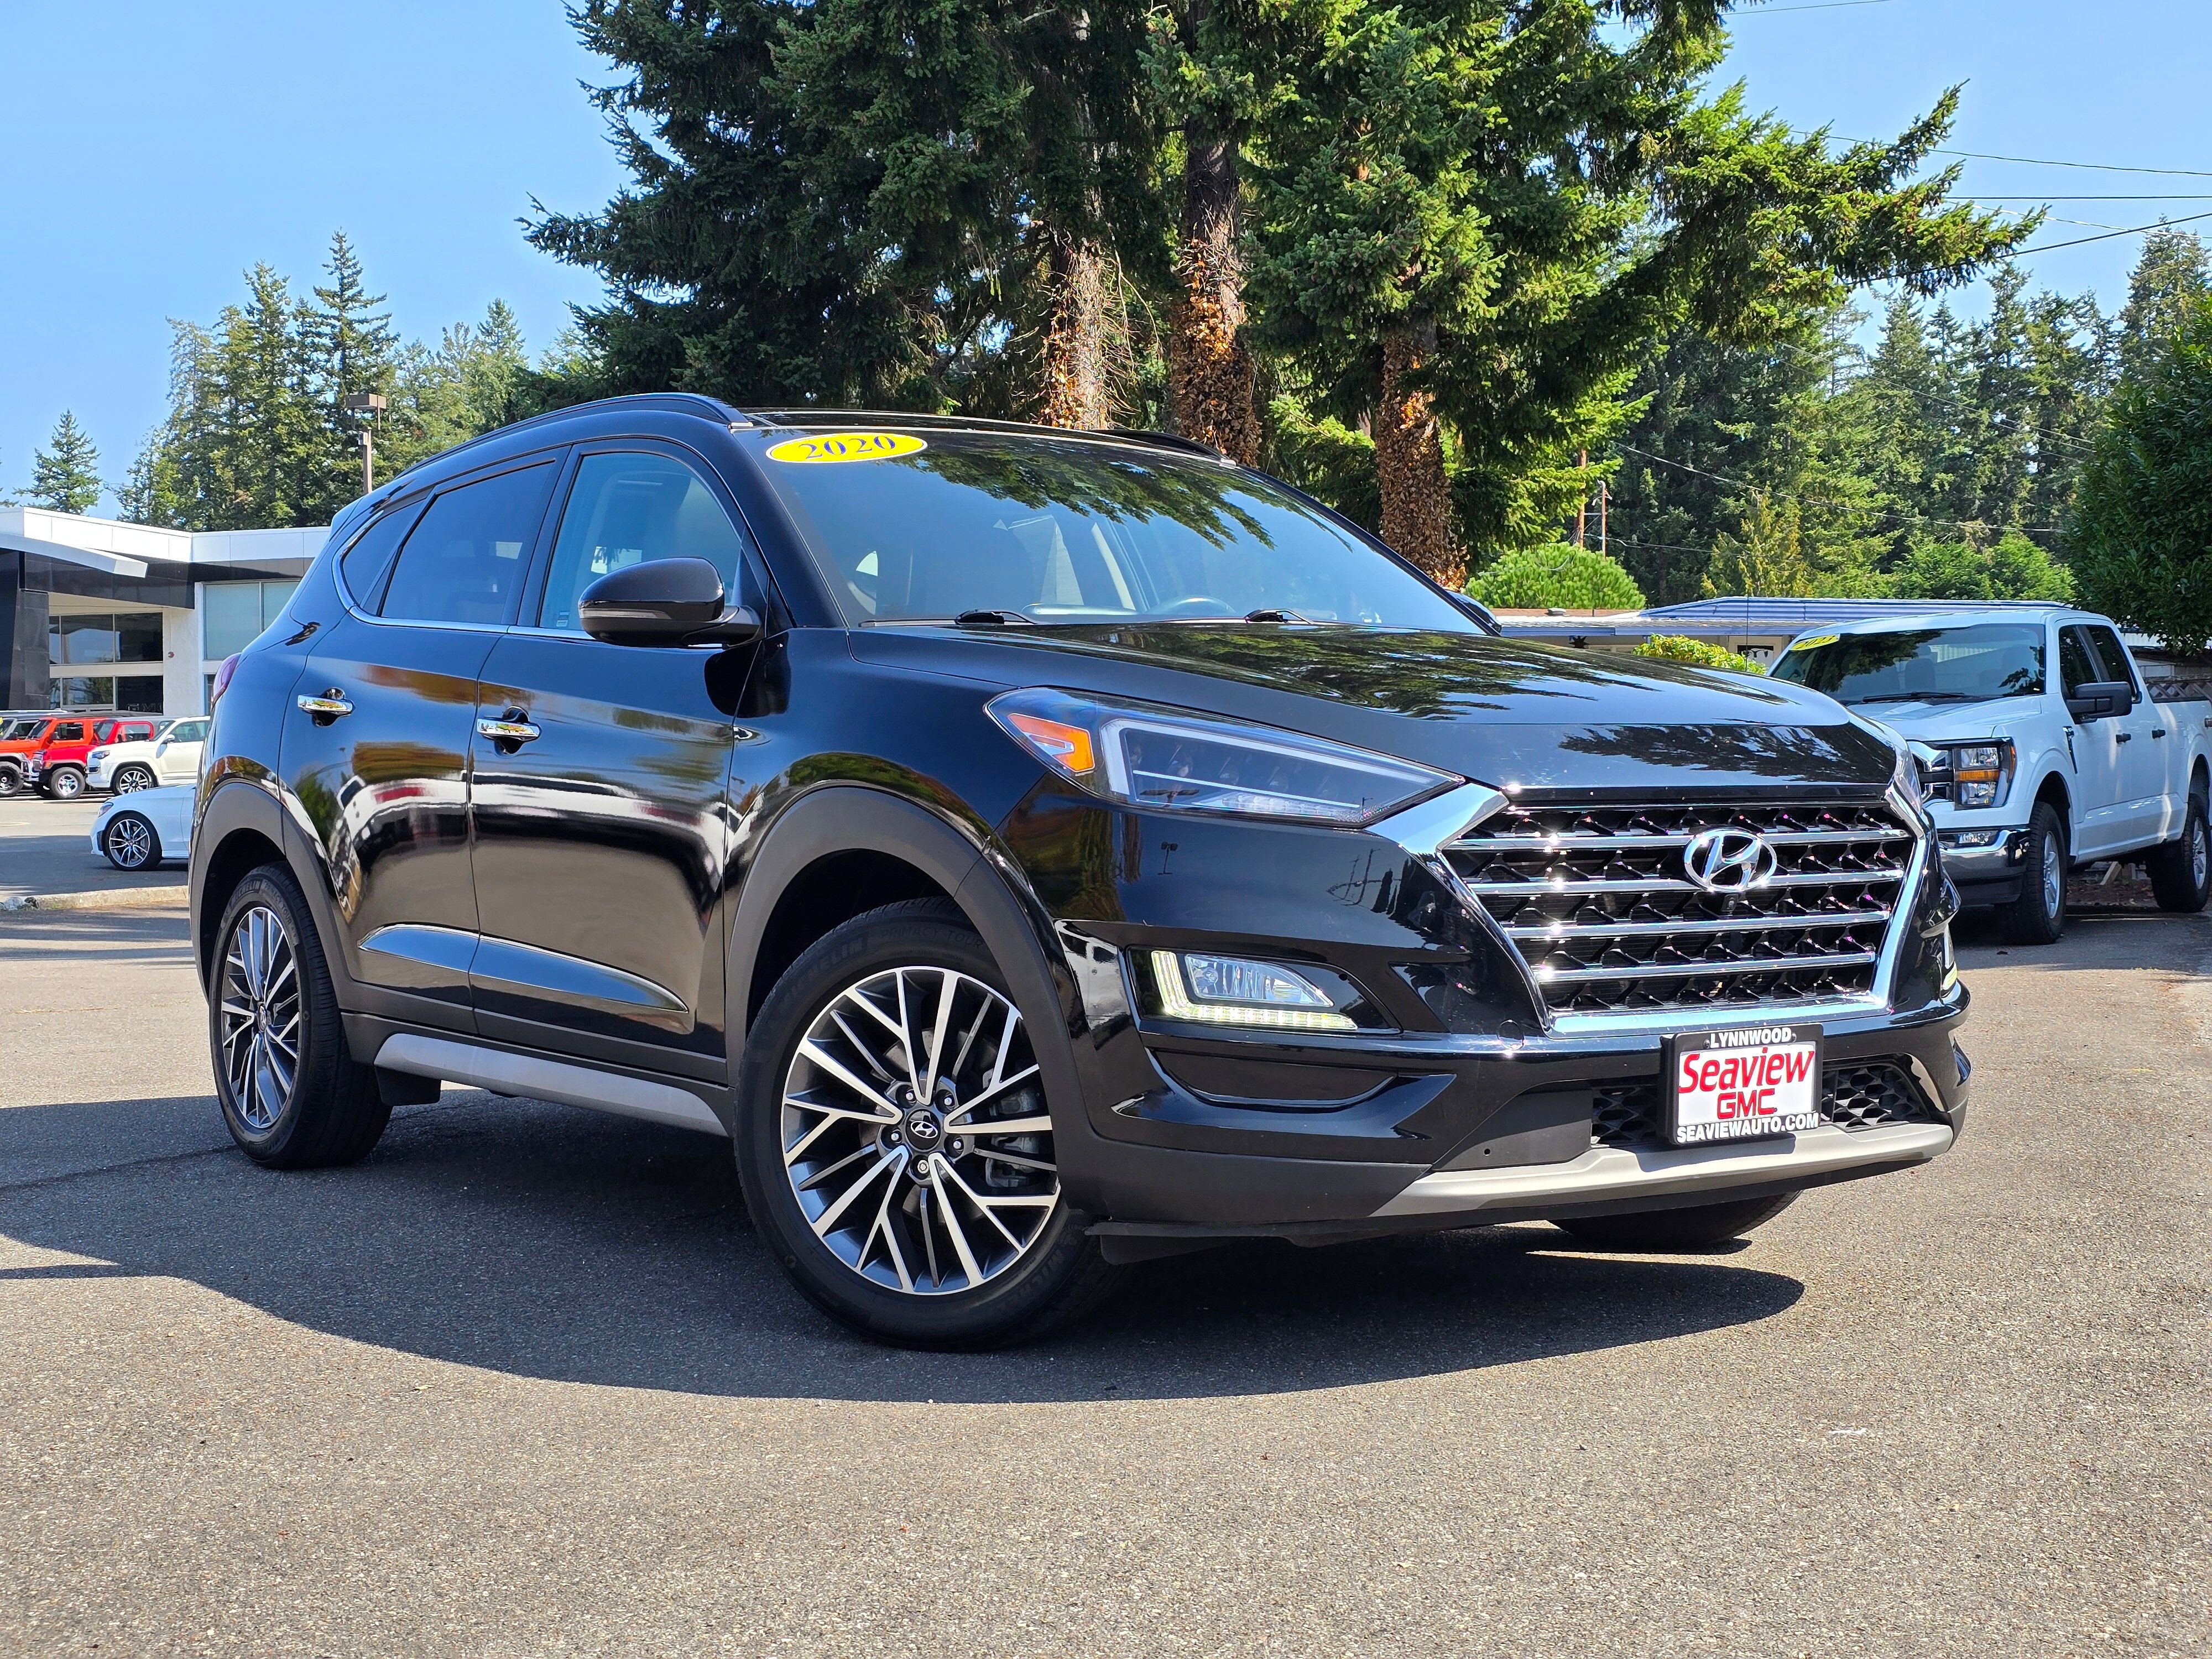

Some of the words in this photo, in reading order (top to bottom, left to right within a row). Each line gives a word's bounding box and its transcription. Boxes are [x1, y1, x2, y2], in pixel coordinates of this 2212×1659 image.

[798, 435, 896, 460] 2020
[231, 880, 261, 906] MICHELIN
[281, 904, 292, 925] TOUR
[880, 926, 942, 939] PRIMACY
[947, 930, 984, 949] TOUR
[1710, 1027, 1792, 1048] LYNNWOOD
[1678, 1047, 1815, 1093] Seaview
[1717, 1088, 1777, 1120] GMC
[1676, 1112, 1819, 1144] SEAVIEWAUTO.COM
